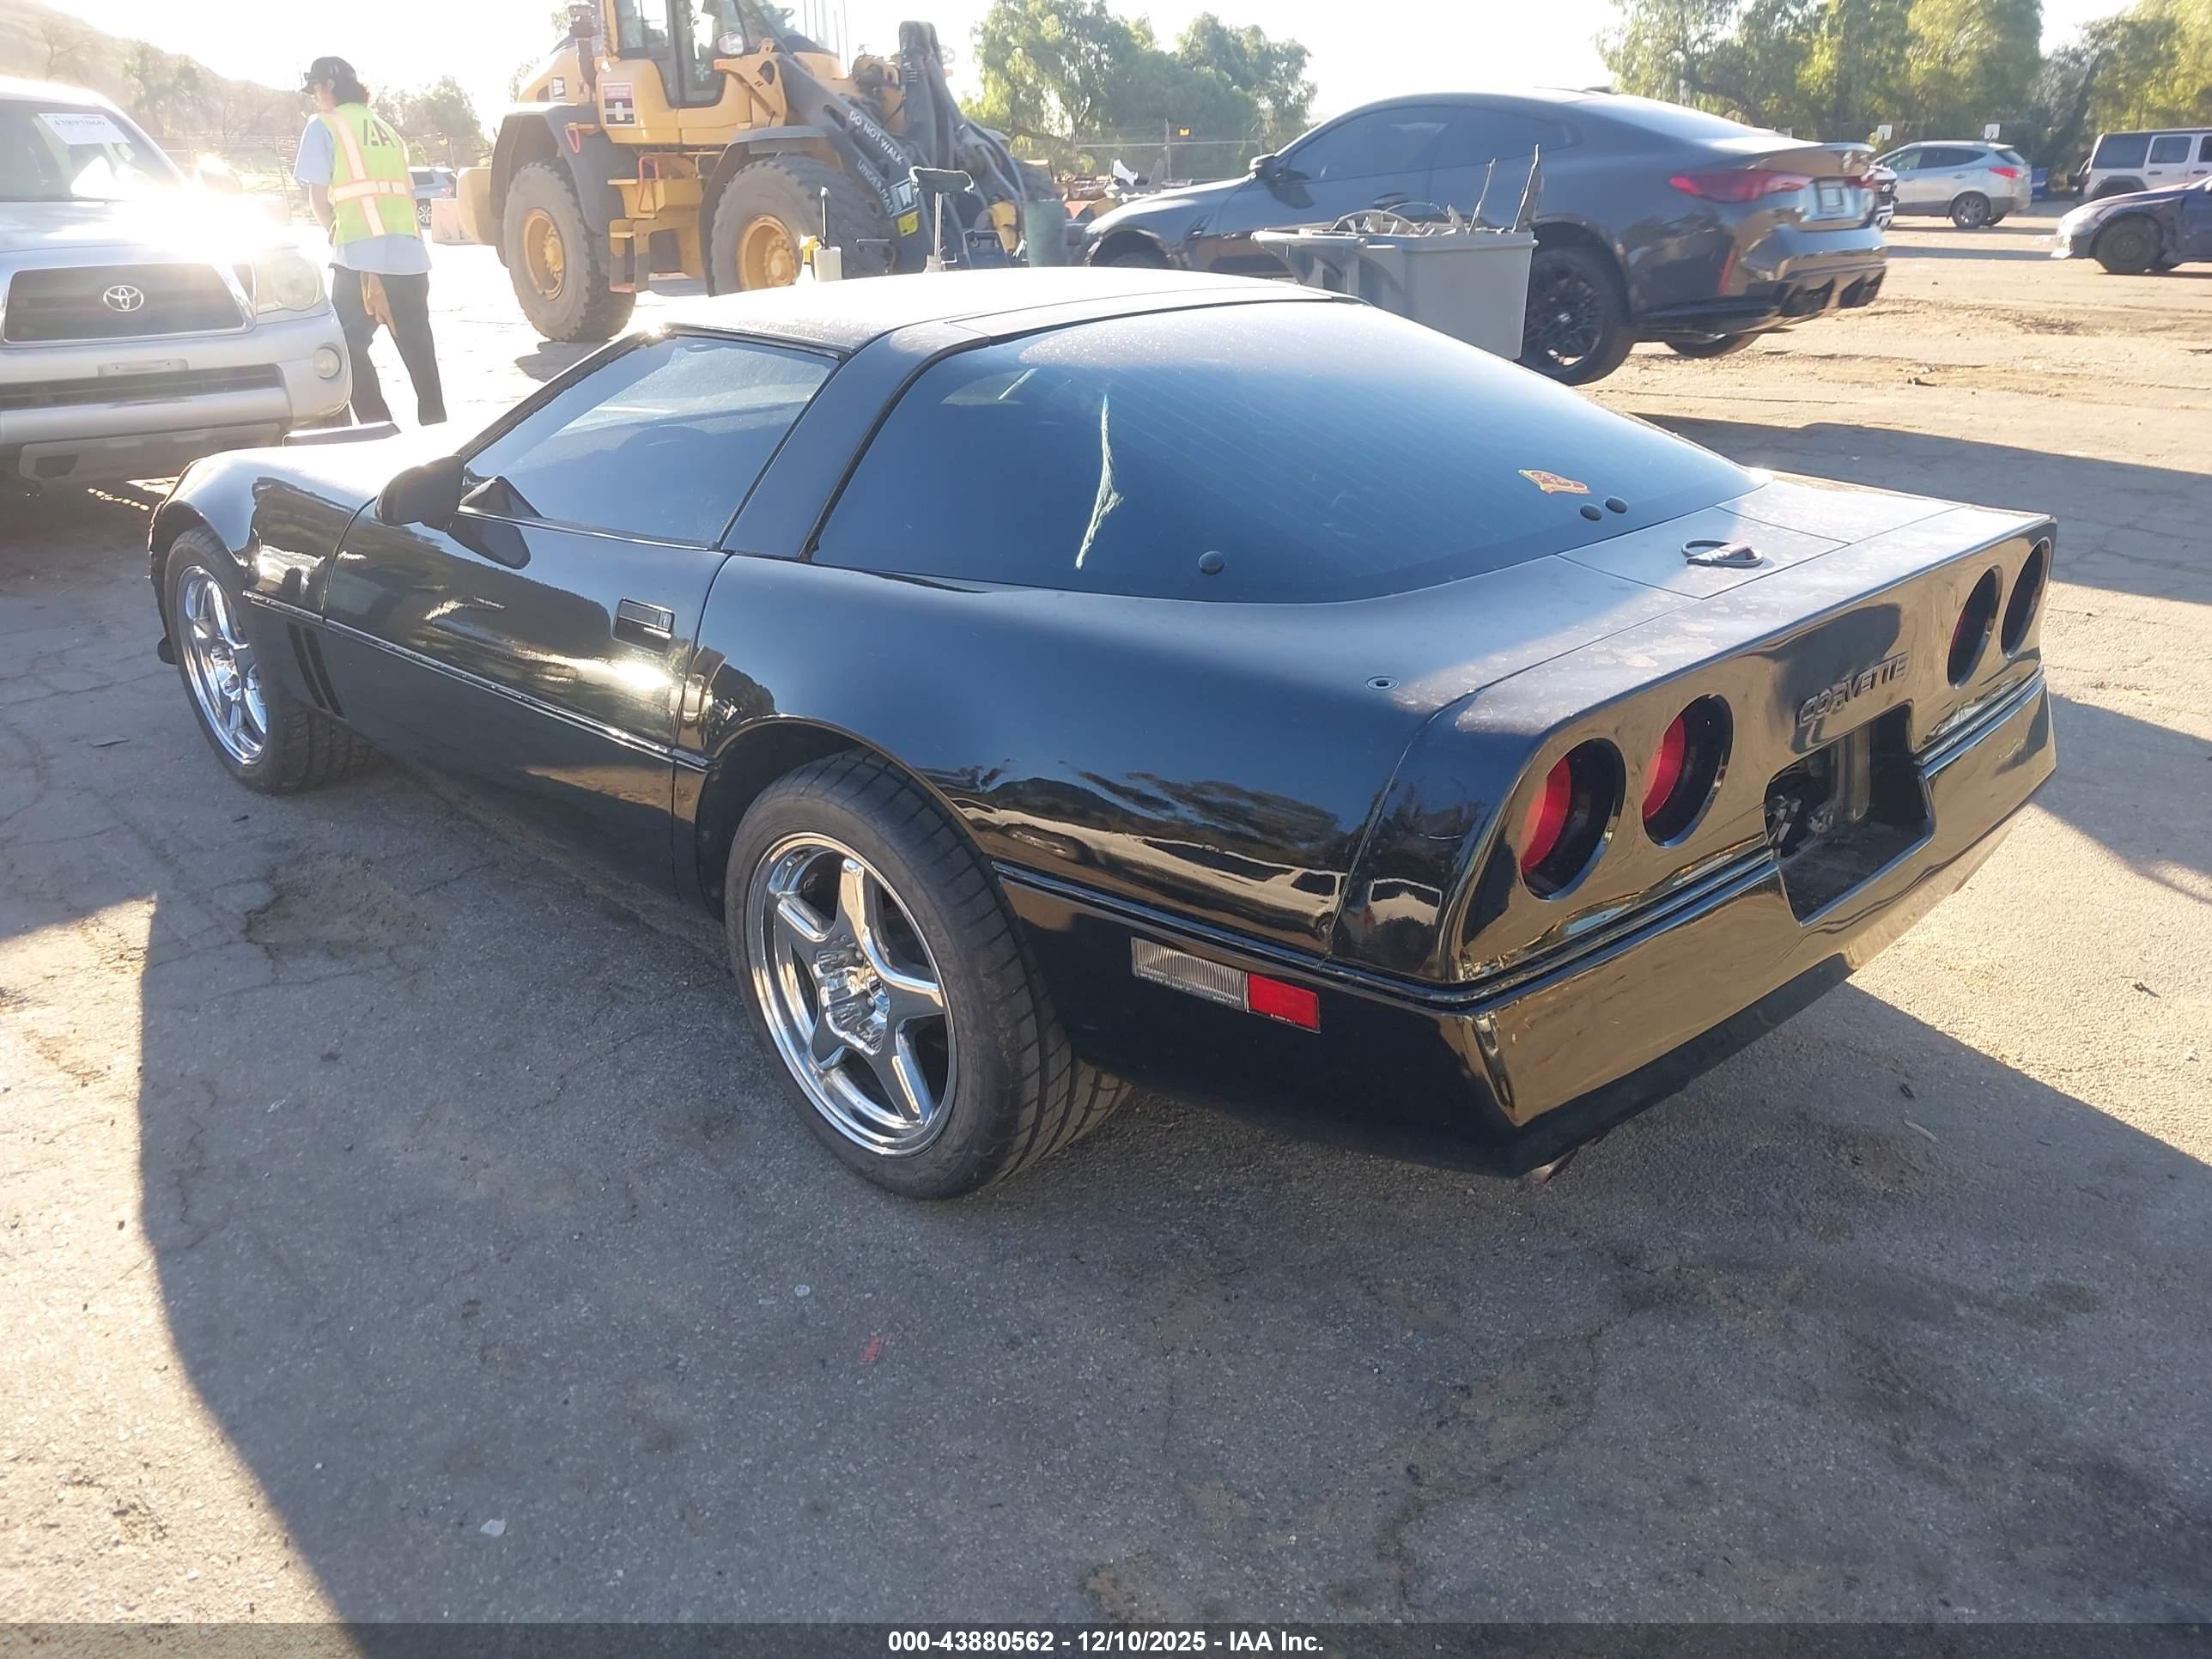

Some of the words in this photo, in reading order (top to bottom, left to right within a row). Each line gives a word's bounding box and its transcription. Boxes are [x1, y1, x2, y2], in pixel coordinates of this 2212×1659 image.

[848, 110, 862, 125] DO
[863, 123, 881, 142] NOT
[880, 138, 903, 165] WALK
[1796, 651, 1909, 728] CORVETTE
